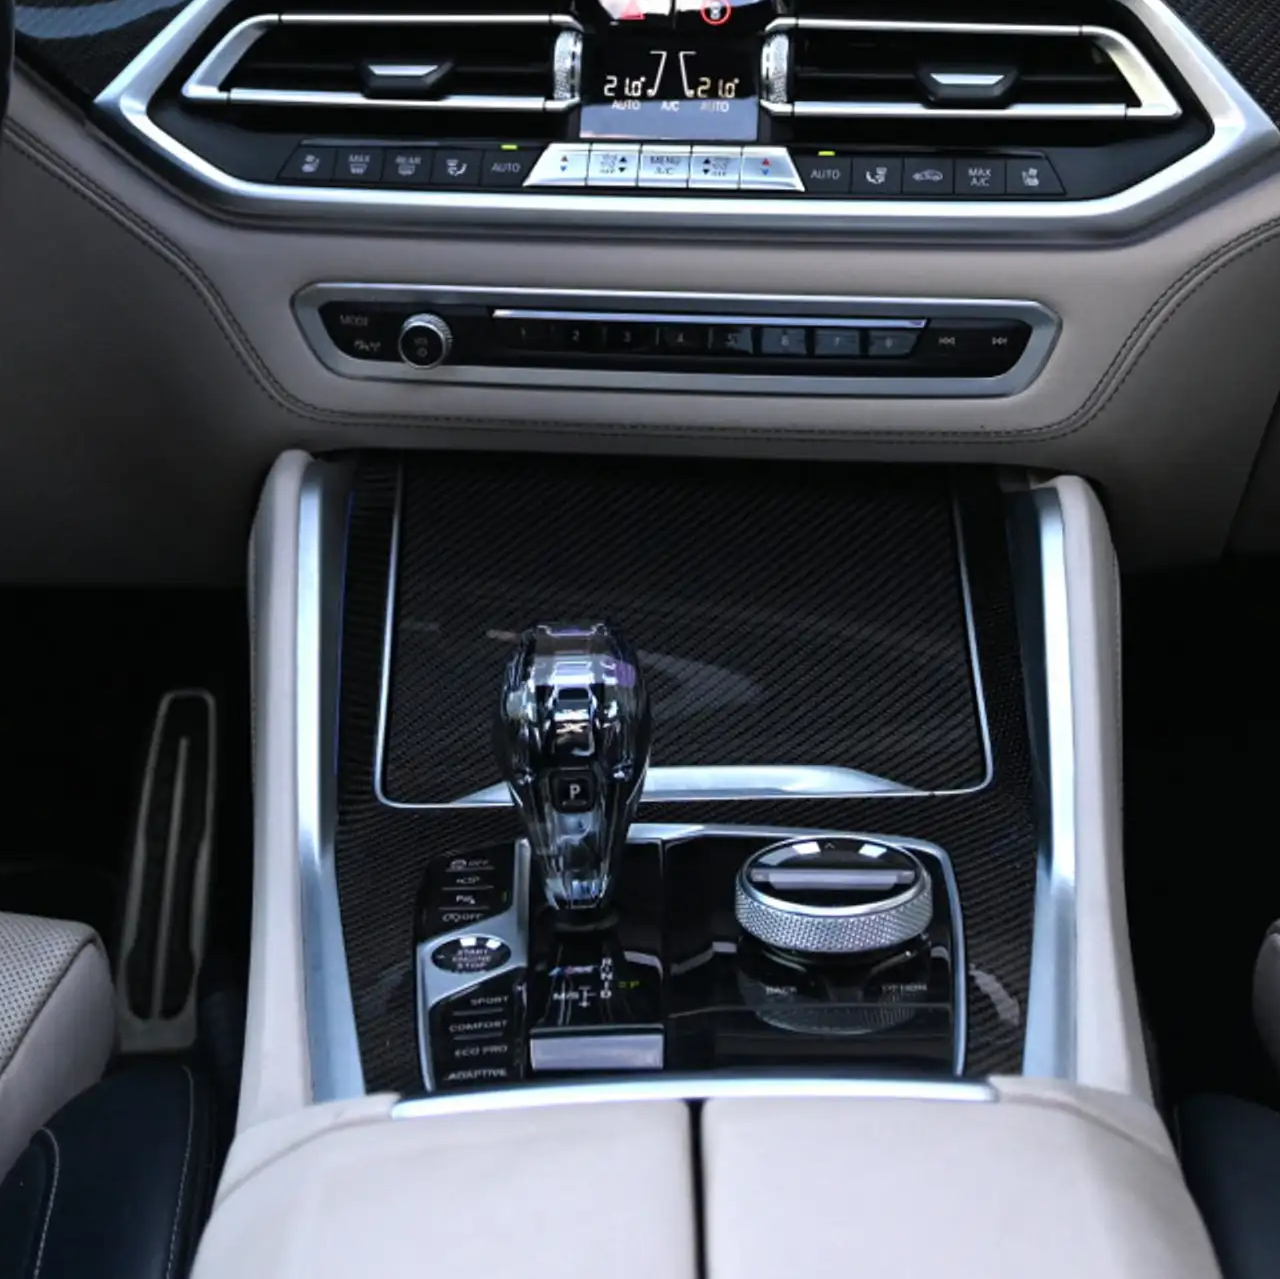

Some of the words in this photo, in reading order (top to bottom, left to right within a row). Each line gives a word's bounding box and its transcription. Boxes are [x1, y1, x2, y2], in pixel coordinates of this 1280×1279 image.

[612, 101, 641, 110] AUTO
[700, 102, 730, 112] AUTO
[491, 162, 521, 172] AUTO
[810, 169, 841, 179] AUTO
[968, 168, 992, 178] MAX
[569, 783, 581, 800] P
[469, 995, 510, 1006] SPORT
[448, 1020, 508, 1033] COMFORT
[454, 1047, 480, 1058] ECO
[482, 1044, 509, 1055] PRO
[445, 1068, 507, 1081] ADAPTIVE
